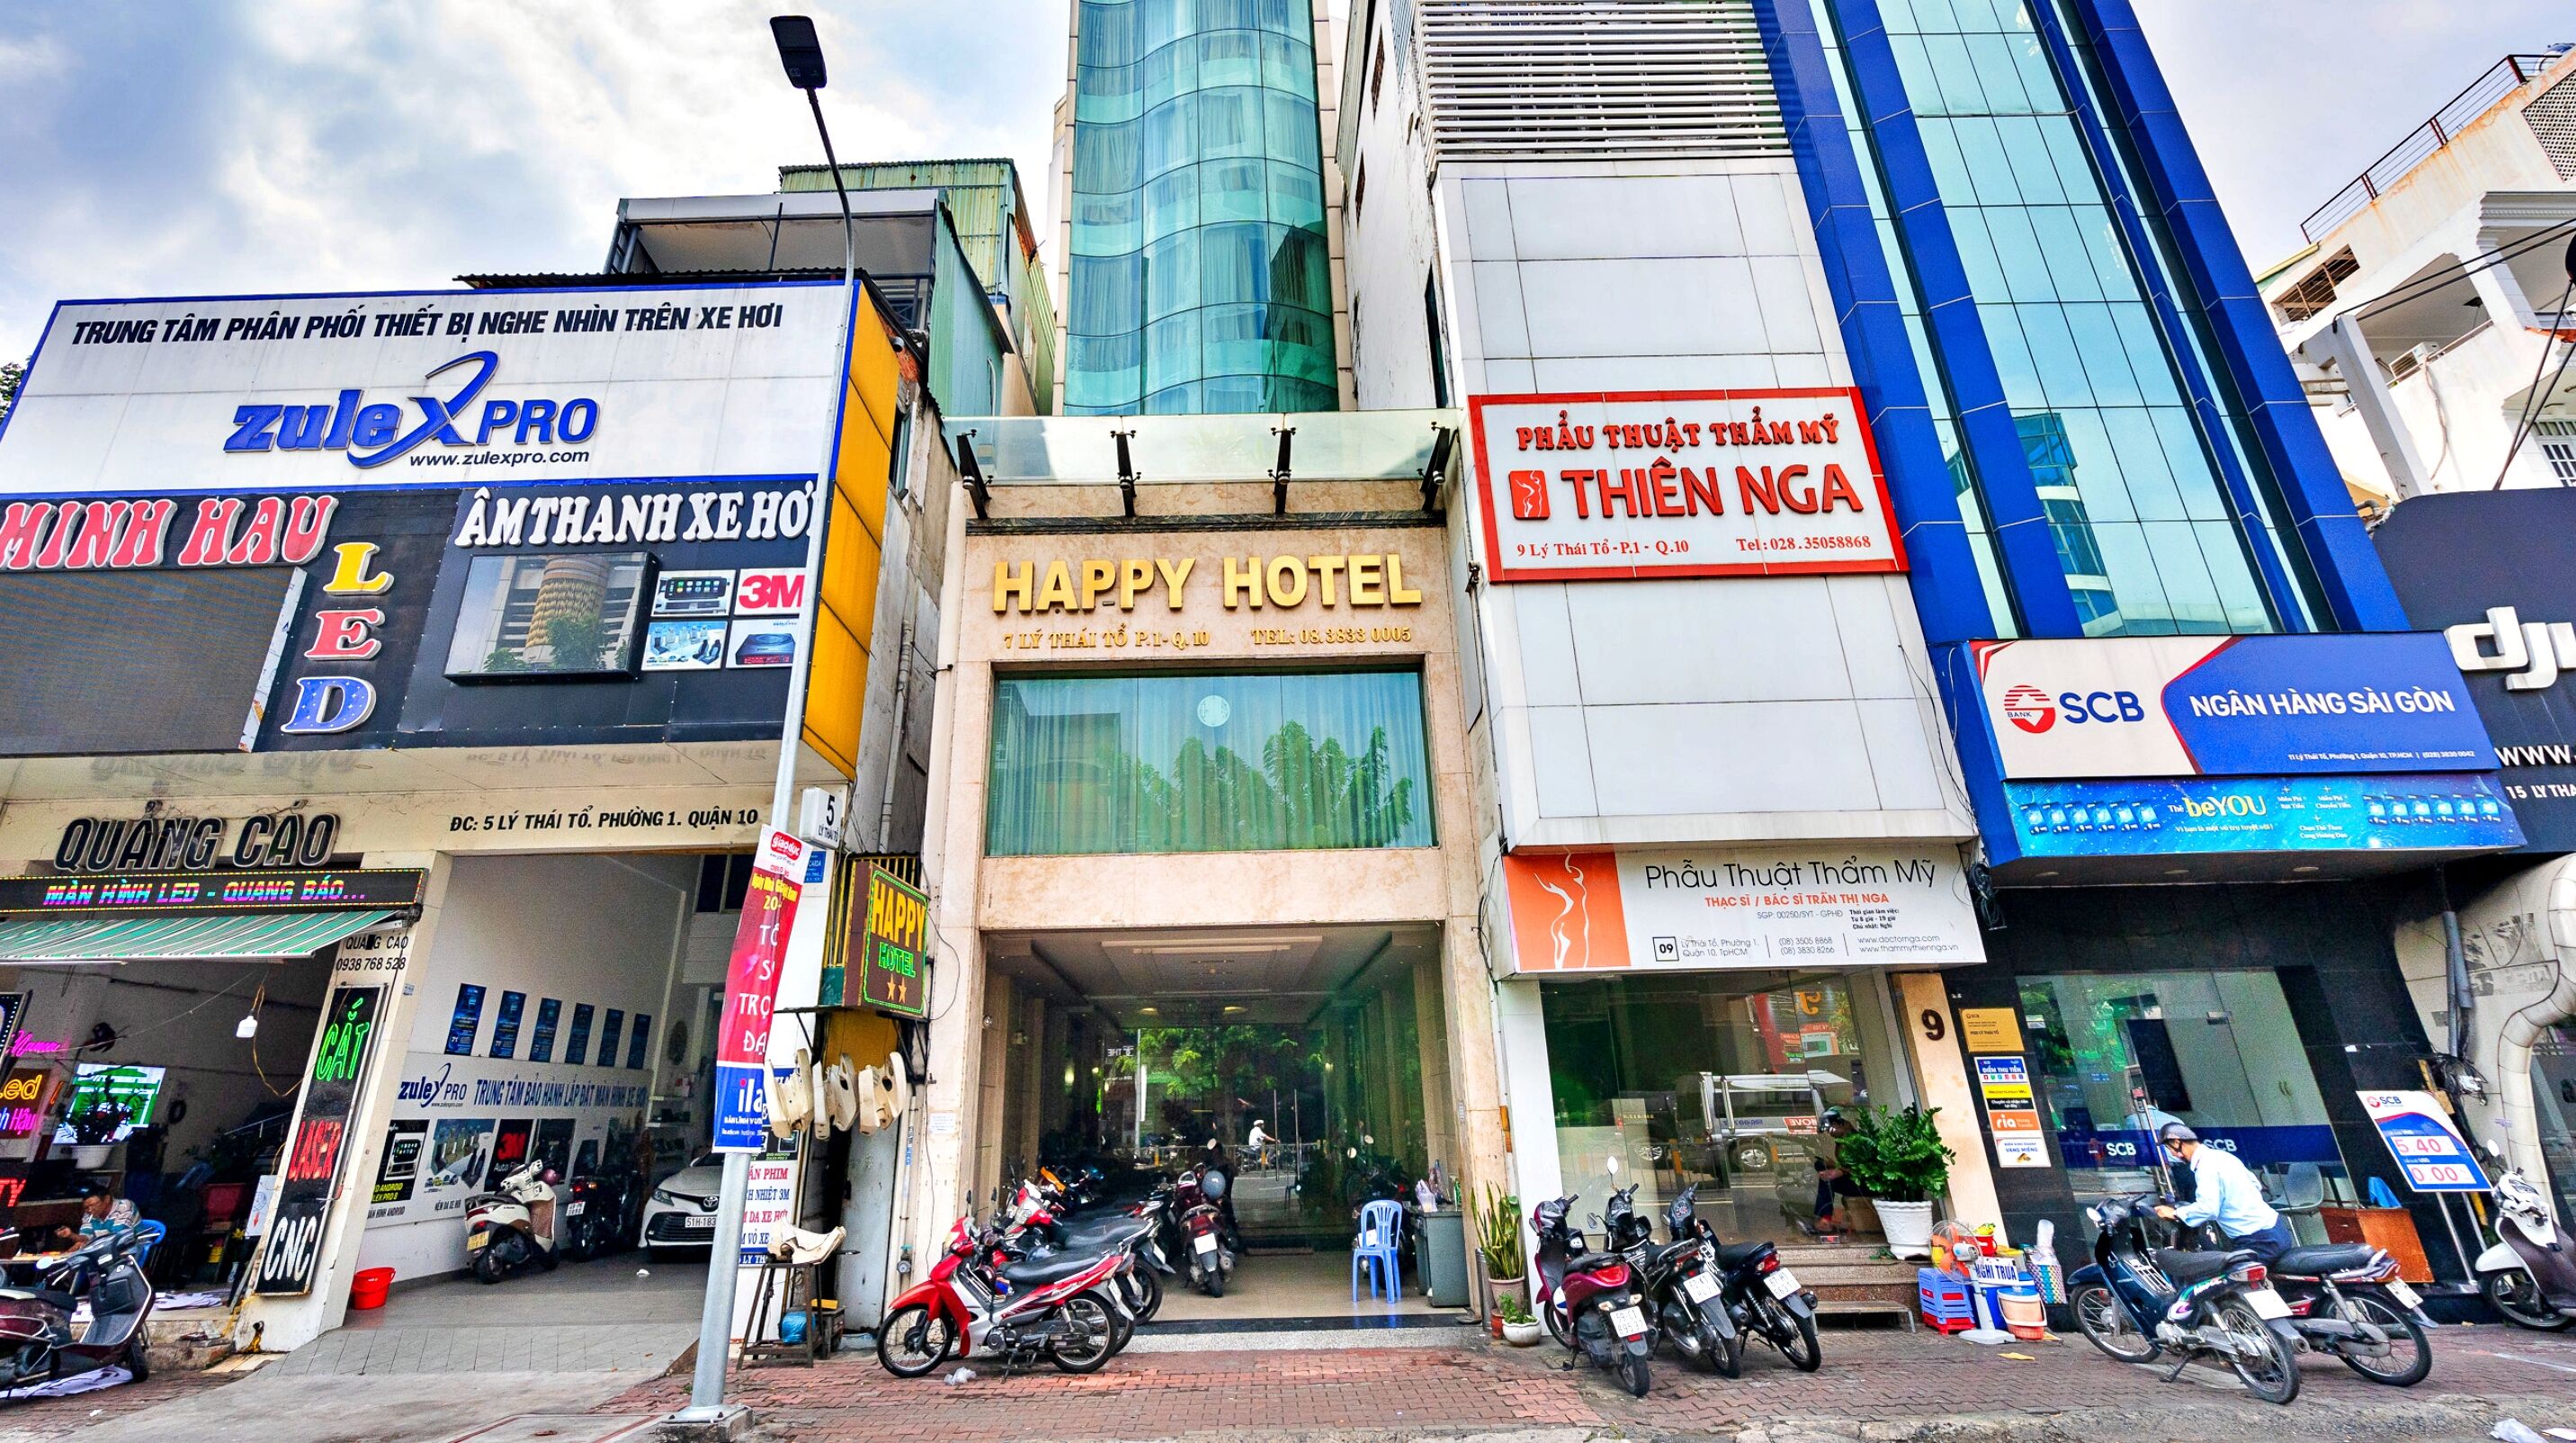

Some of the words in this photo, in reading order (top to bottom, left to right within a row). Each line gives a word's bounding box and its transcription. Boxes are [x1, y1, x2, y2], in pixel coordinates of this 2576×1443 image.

[72, 318, 157, 345] TRUNG
[161, 313, 221, 342] TÂM
[223, 310, 300, 340] PHÂN
[304, 304, 365, 338] PHỐI
[374, 304, 443, 337] THIẾT
[446, 311, 474, 343] BỊ
[478, 310, 549, 334] NGHE
[553, 303, 619, 333] NHÌN
[624, 302, 691, 331] TRÊN
[697, 306, 733, 329] XE
[738, 303, 783, 328] HƠI
[1603, 417, 1701, 453] THUẬT
[1709, 406, 1796, 446] THẨM
[1797, 413, 1839, 444] MỸ
[409, 449, 590, 468] www.zulexpro.com
[1561, 456, 1724, 518] THIÊN
[1736, 463, 1865, 515] NGA
[454, 486, 530, 547] ÂM
[528, 494, 684, 545] THANH
[683, 490, 745, 542] XE
[0, 499, 177, 570] MINH
[178, 496, 339, 566] HAU
[1516, 542, 1526, 556] 9
[1530, 542, 1549, 559] Lý
[1554, 542, 1588, 556] Thái
[1590, 538, 1611, 555] Tổ
[1655, 540, 1690, 555] Q.10
[738, 574, 806, 609] 3M
[993, 557, 1195, 613] HAPPY
[1223, 553, 1423, 609] HOTEL
[1004, 632, 1014, 650] 7
[1018, 627, 1043, 650] LÝ
[1049, 627, 1097, 649] THÁI
[1102, 623, 1129, 648] TỔ
[1251, 629, 1295, 645] TEL:
[1372, 626, 1412, 643] 0005
[2059, 691, 2145, 724] SCB
[2190, 689, 2277, 717] NGÂN
[2282, 686, 2346, 715] HÀNG
[2348, 686, 2393, 714] SÀI
[2399, 686, 2455, 713] GÒN
[2182, 794, 2268, 818] beYOU
[2506, 786, 2527, 800] 15
[450, 816, 478, 832] ĐC:
[483, 815, 494, 830] 5
[497, 809, 520, 830] LÝ
[524, 810, 562, 829] THÁI
[599, 806, 665, 828] PHƯỜNG
[688, 810, 731, 829] QUẬN
[736, 809, 758, 825] 10
[826, 795, 836, 827] 5
[1645, 858, 1717, 890] Phẫu
[1723, 861, 1802, 891] Thuật
[1808, 856, 1888, 886] Thẩm
[1894, 858, 1936, 888] Mỹ
[43, 880, 96, 906] MÀN
[99, 878, 153, 905] HÌNH
[156, 883, 201, 903] LED
[1704, 896, 1738, 910] THẠC
[1740, 893, 1751, 907] SĨ
[1764, 892, 1790, 906] BÁC
[1793, 892, 1804, 906] SĨ
[1839, 892, 1860, 907] THỊ
[1862, 893, 1890, 904] NGA
[871, 878, 926, 953] HAPPY
[1659, 944, 1674, 955] 09
[1683, 949, 1705, 957] Quận
[1778, 937, 1794, 946] (08)
[1795, 937, 1814, 946] 3505
[1814, 937, 1833, 945] 8868
[1780, 946, 1796, 955] (08)
[1797, 946, 1817, 955] 3830
[1818, 946, 1835, 954] 8266
[335, 958, 362, 971] 0938
[363, 957, 384, 971] 768
[385, 956, 407, 970] 528
[878, 941, 917, 979] HOTEL
[1921, 1009, 1945, 1041] 9
[317, 997, 370, 1082] CẮT
[443, 1083, 468, 1100] PRO
[473, 1080, 505, 1107] TRUNG
[505, 1073, 524, 1107] TÂM
[523, 1072, 541, 1107] BẢO
[738, 1077, 763, 1113] ila
[2379, 1096, 2402, 1105] SCB
[1996, 1114, 2017, 1128] ria
[497, 1133, 528, 1161] 3M
[2106, 1142, 2137, 1157] SCB
[764, 1168, 789, 1180] PHIM
[779, 1188, 790, 1201] 3M
[749, 1210, 760, 1223] DA
[762, 1210, 773, 1223] XE
[264, 1215, 318, 1285] CNC
